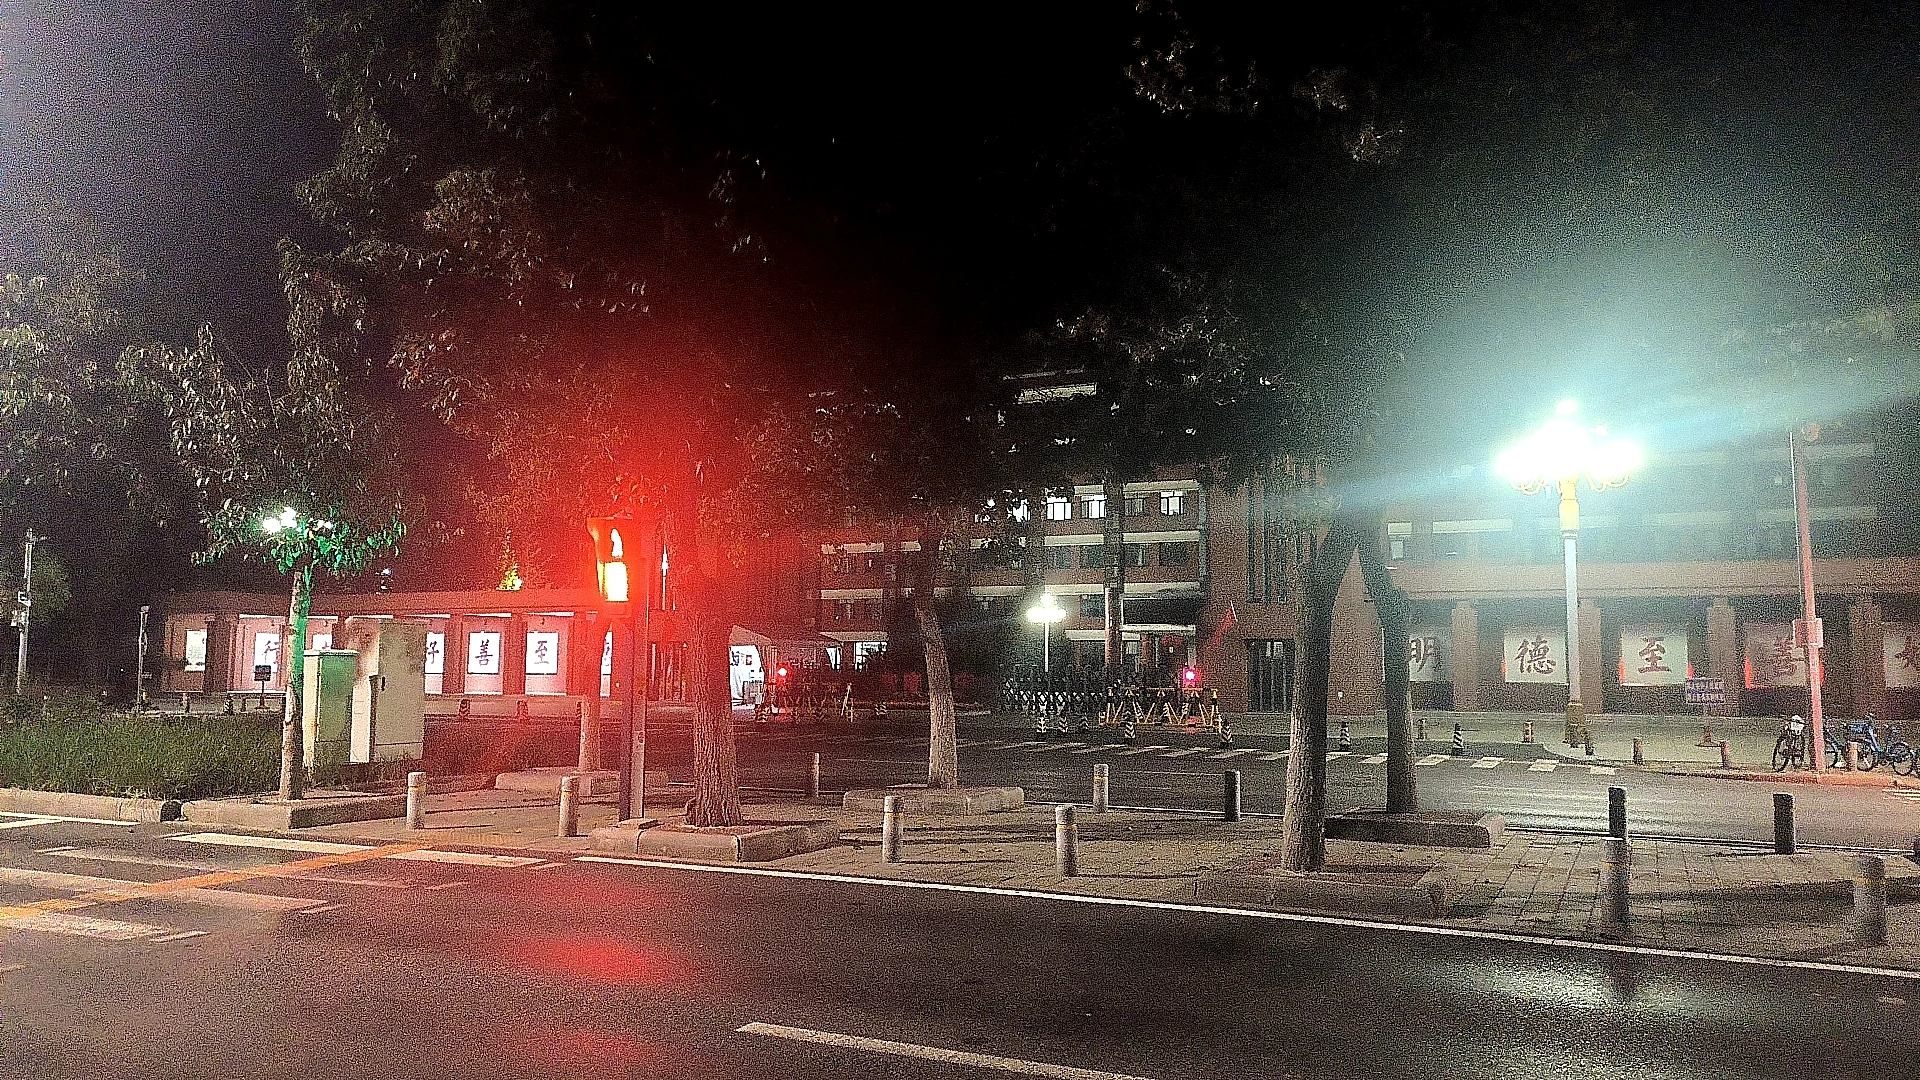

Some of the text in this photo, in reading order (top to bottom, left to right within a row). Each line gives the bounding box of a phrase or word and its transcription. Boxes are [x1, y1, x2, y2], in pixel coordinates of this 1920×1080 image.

[475, 639, 493, 666] 善
[533, 640, 549, 665] 至
[1514, 634, 1556, 675] 德
[1638, 637, 1672, 673] 至
